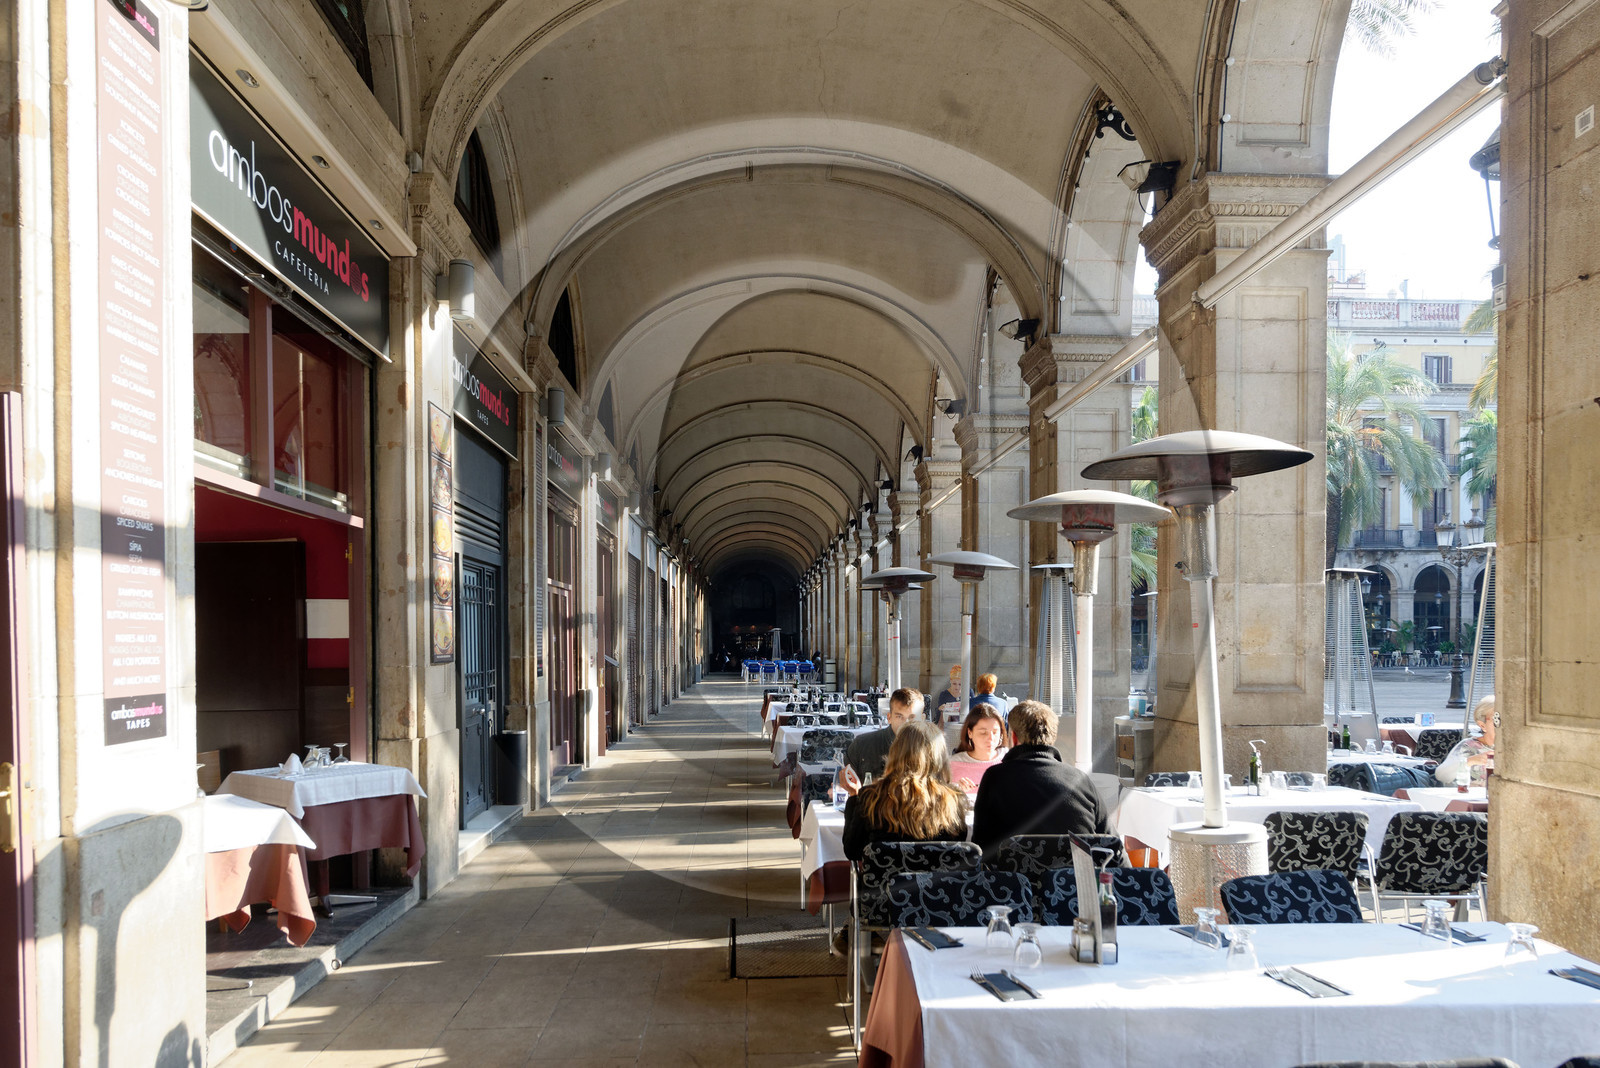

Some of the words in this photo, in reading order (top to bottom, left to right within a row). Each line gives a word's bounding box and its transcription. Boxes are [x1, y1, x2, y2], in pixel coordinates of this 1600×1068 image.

[209, 130, 369, 302] ambosmundos
[275, 240, 330, 295] CAFETERIA
[477, 410, 488, 426] TAPES
[117, 517, 135, 528] SPICED
[136, 520, 153, 531] SNAILS
[126, 718, 151, 730] TAPES
